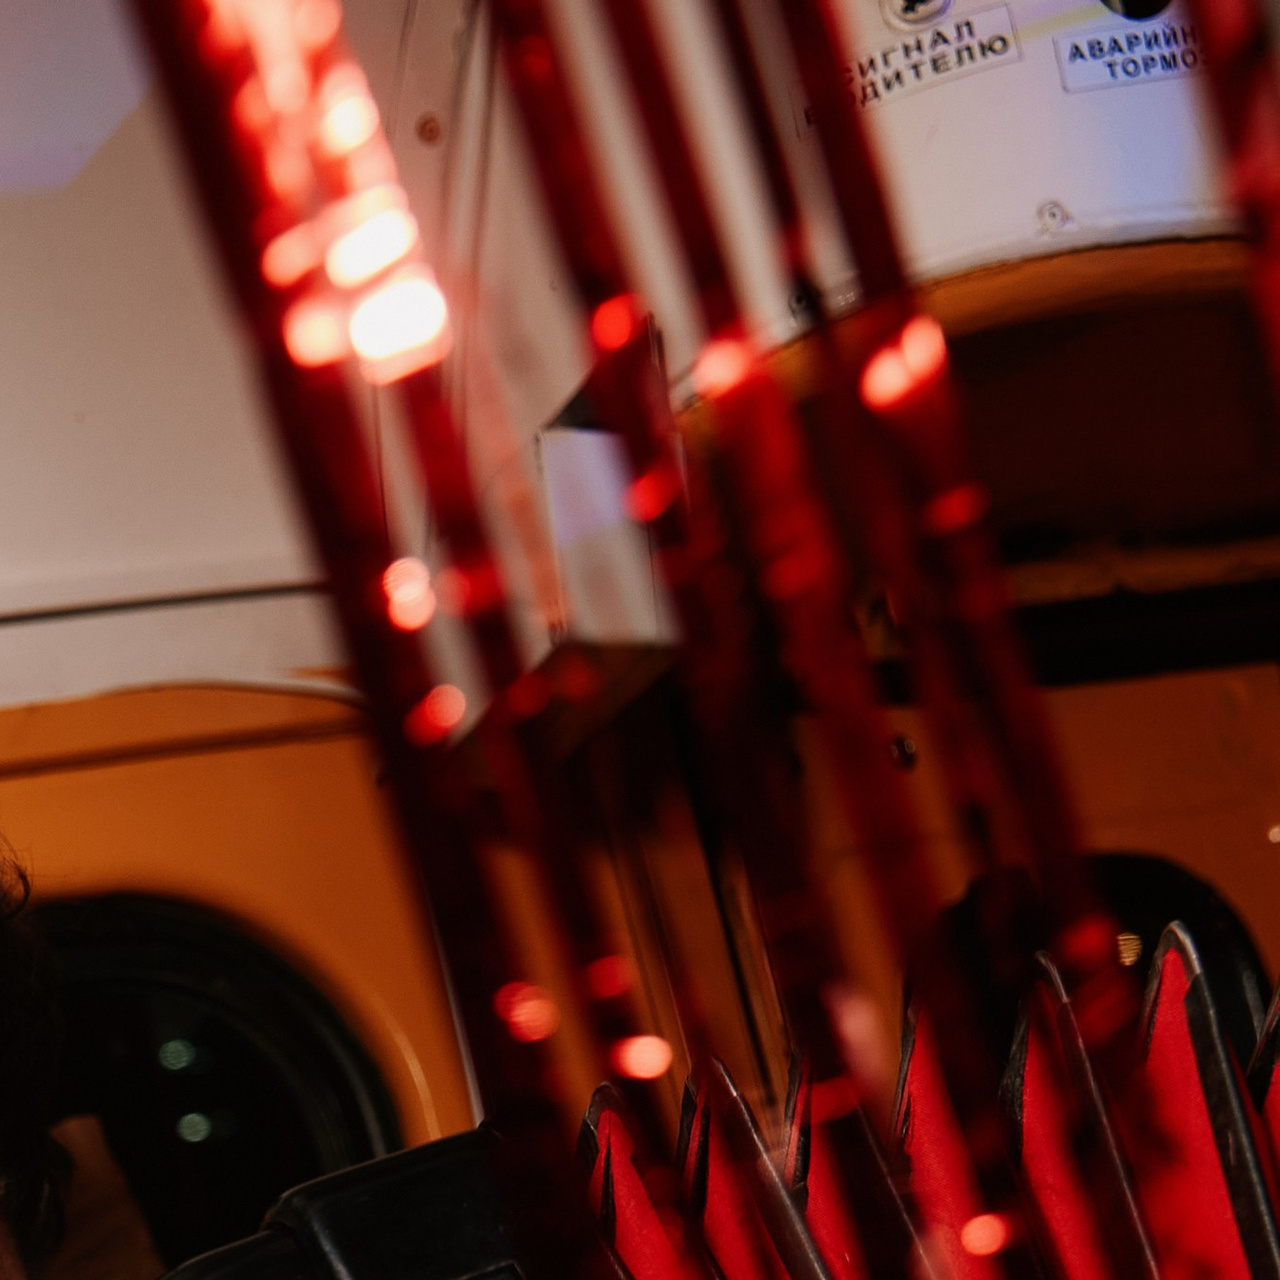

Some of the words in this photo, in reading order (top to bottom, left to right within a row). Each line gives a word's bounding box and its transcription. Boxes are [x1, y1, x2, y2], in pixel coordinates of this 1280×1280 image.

[1069, 23, 1198, 62] АВАРИЙН
[804, 33, 1010, 126] ДИТЕЛЮ
[1104, 48, 1202, 79] ТОРМО
